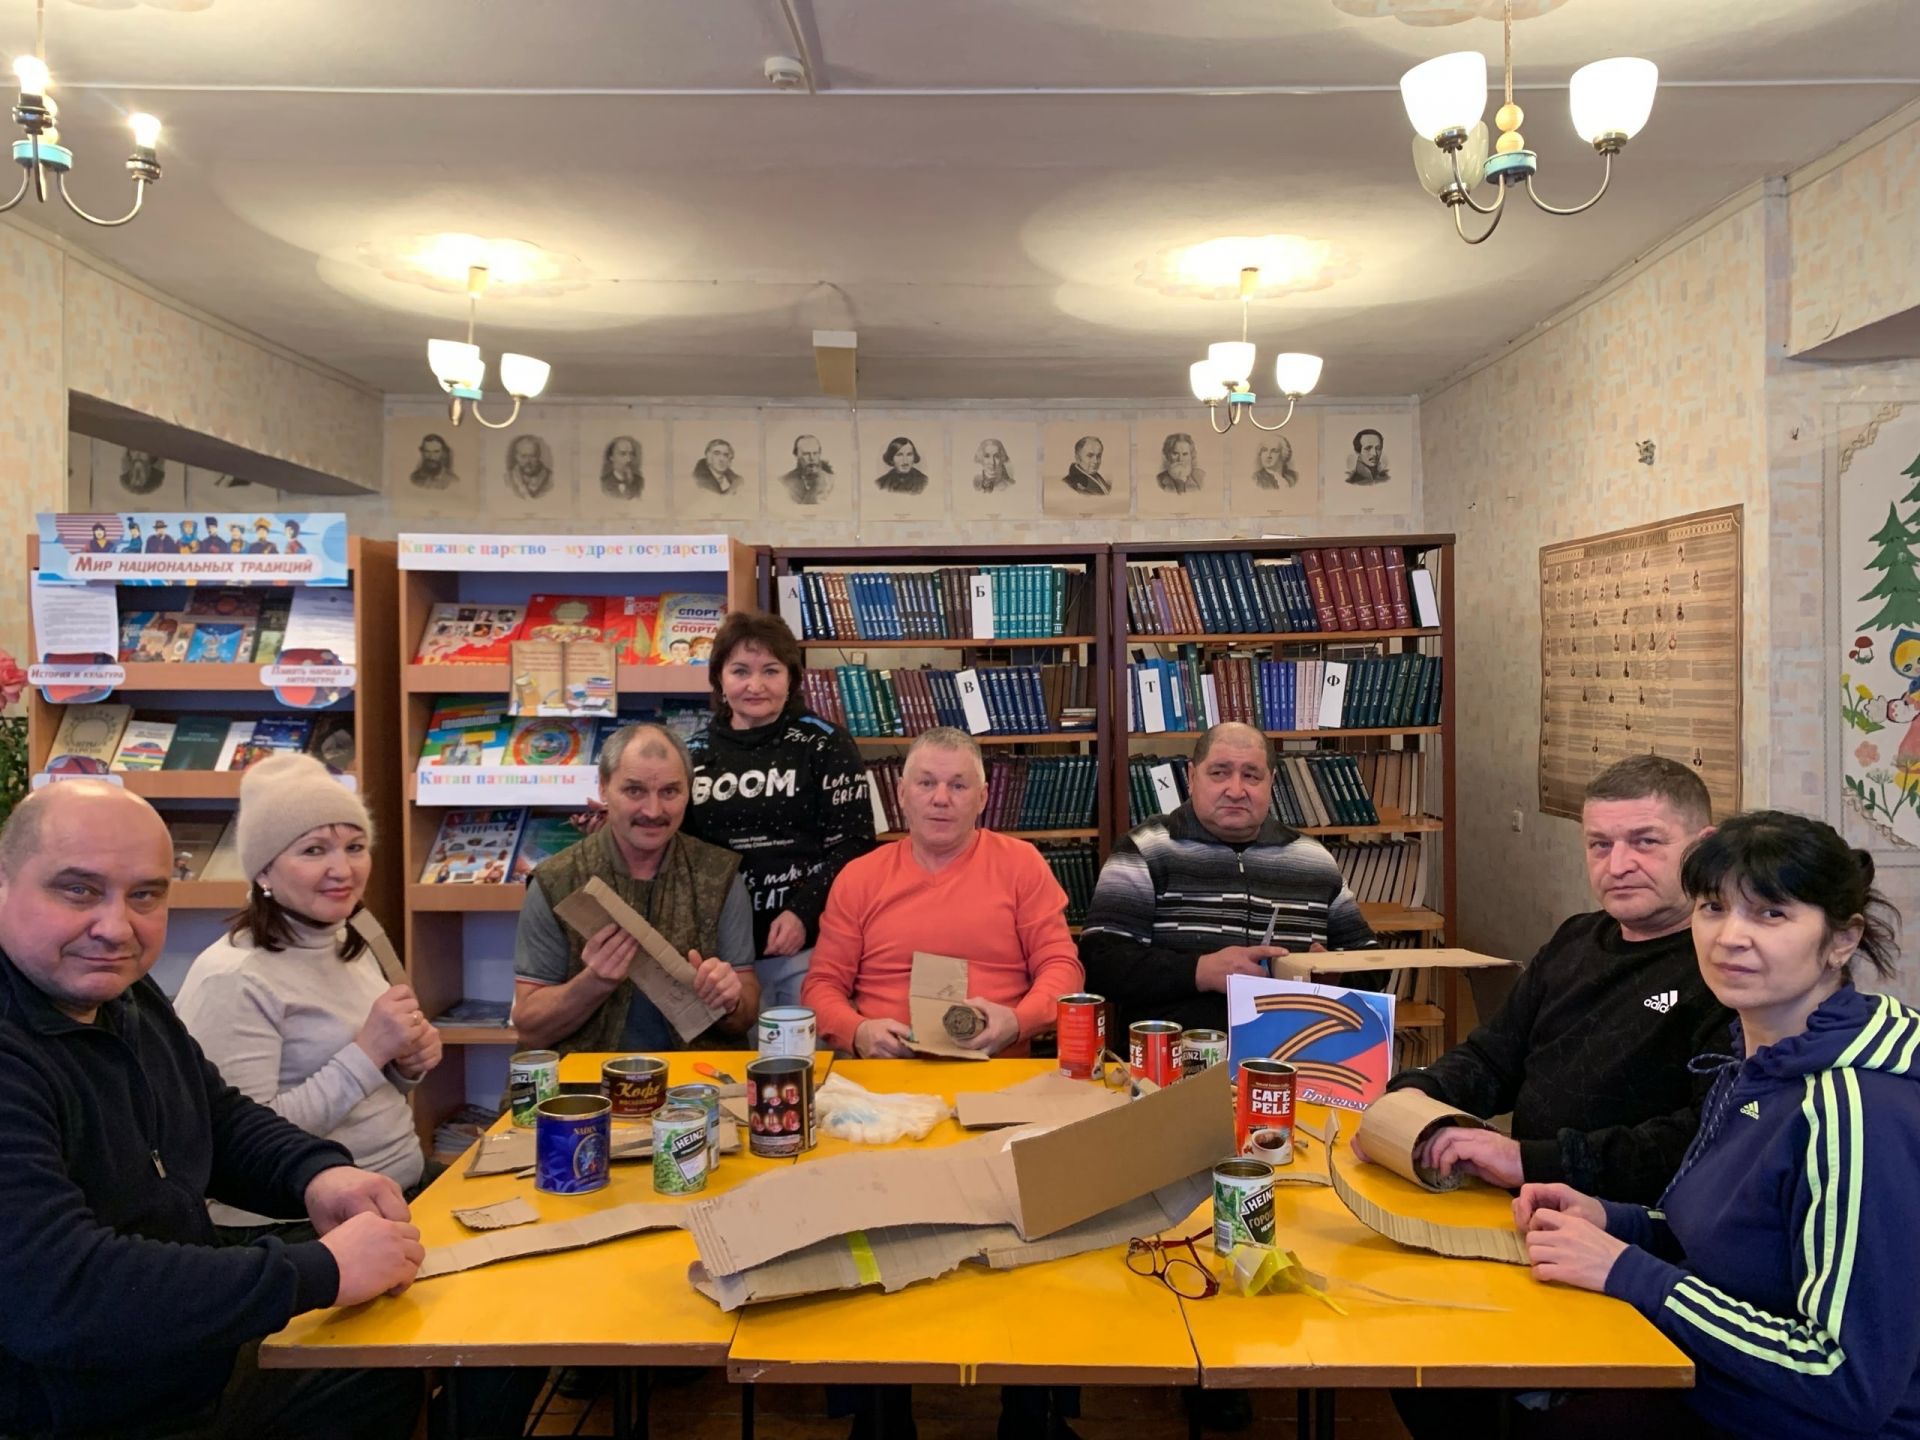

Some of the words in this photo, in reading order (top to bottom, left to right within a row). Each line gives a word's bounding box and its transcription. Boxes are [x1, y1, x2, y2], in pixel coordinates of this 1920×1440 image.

[480, 543, 546, 559] царство
[565, 543, 624, 558] мудрое
[628, 543, 727, 558] государство
[788, 586, 799, 599] А
[975, 585, 986, 598] Б
[678, 607, 719, 617] СПОРТ
[963, 681, 974, 694] В
[1144, 680, 1156, 694] Т
[1326, 674, 1341, 687] Ф
[419, 771, 472, 786] Китап
[1252, 1088, 1291, 1102] CAFÉ
[1252, 1101, 1291, 1115] PELÉ
[676, 1127, 705, 1149] HEINZ
